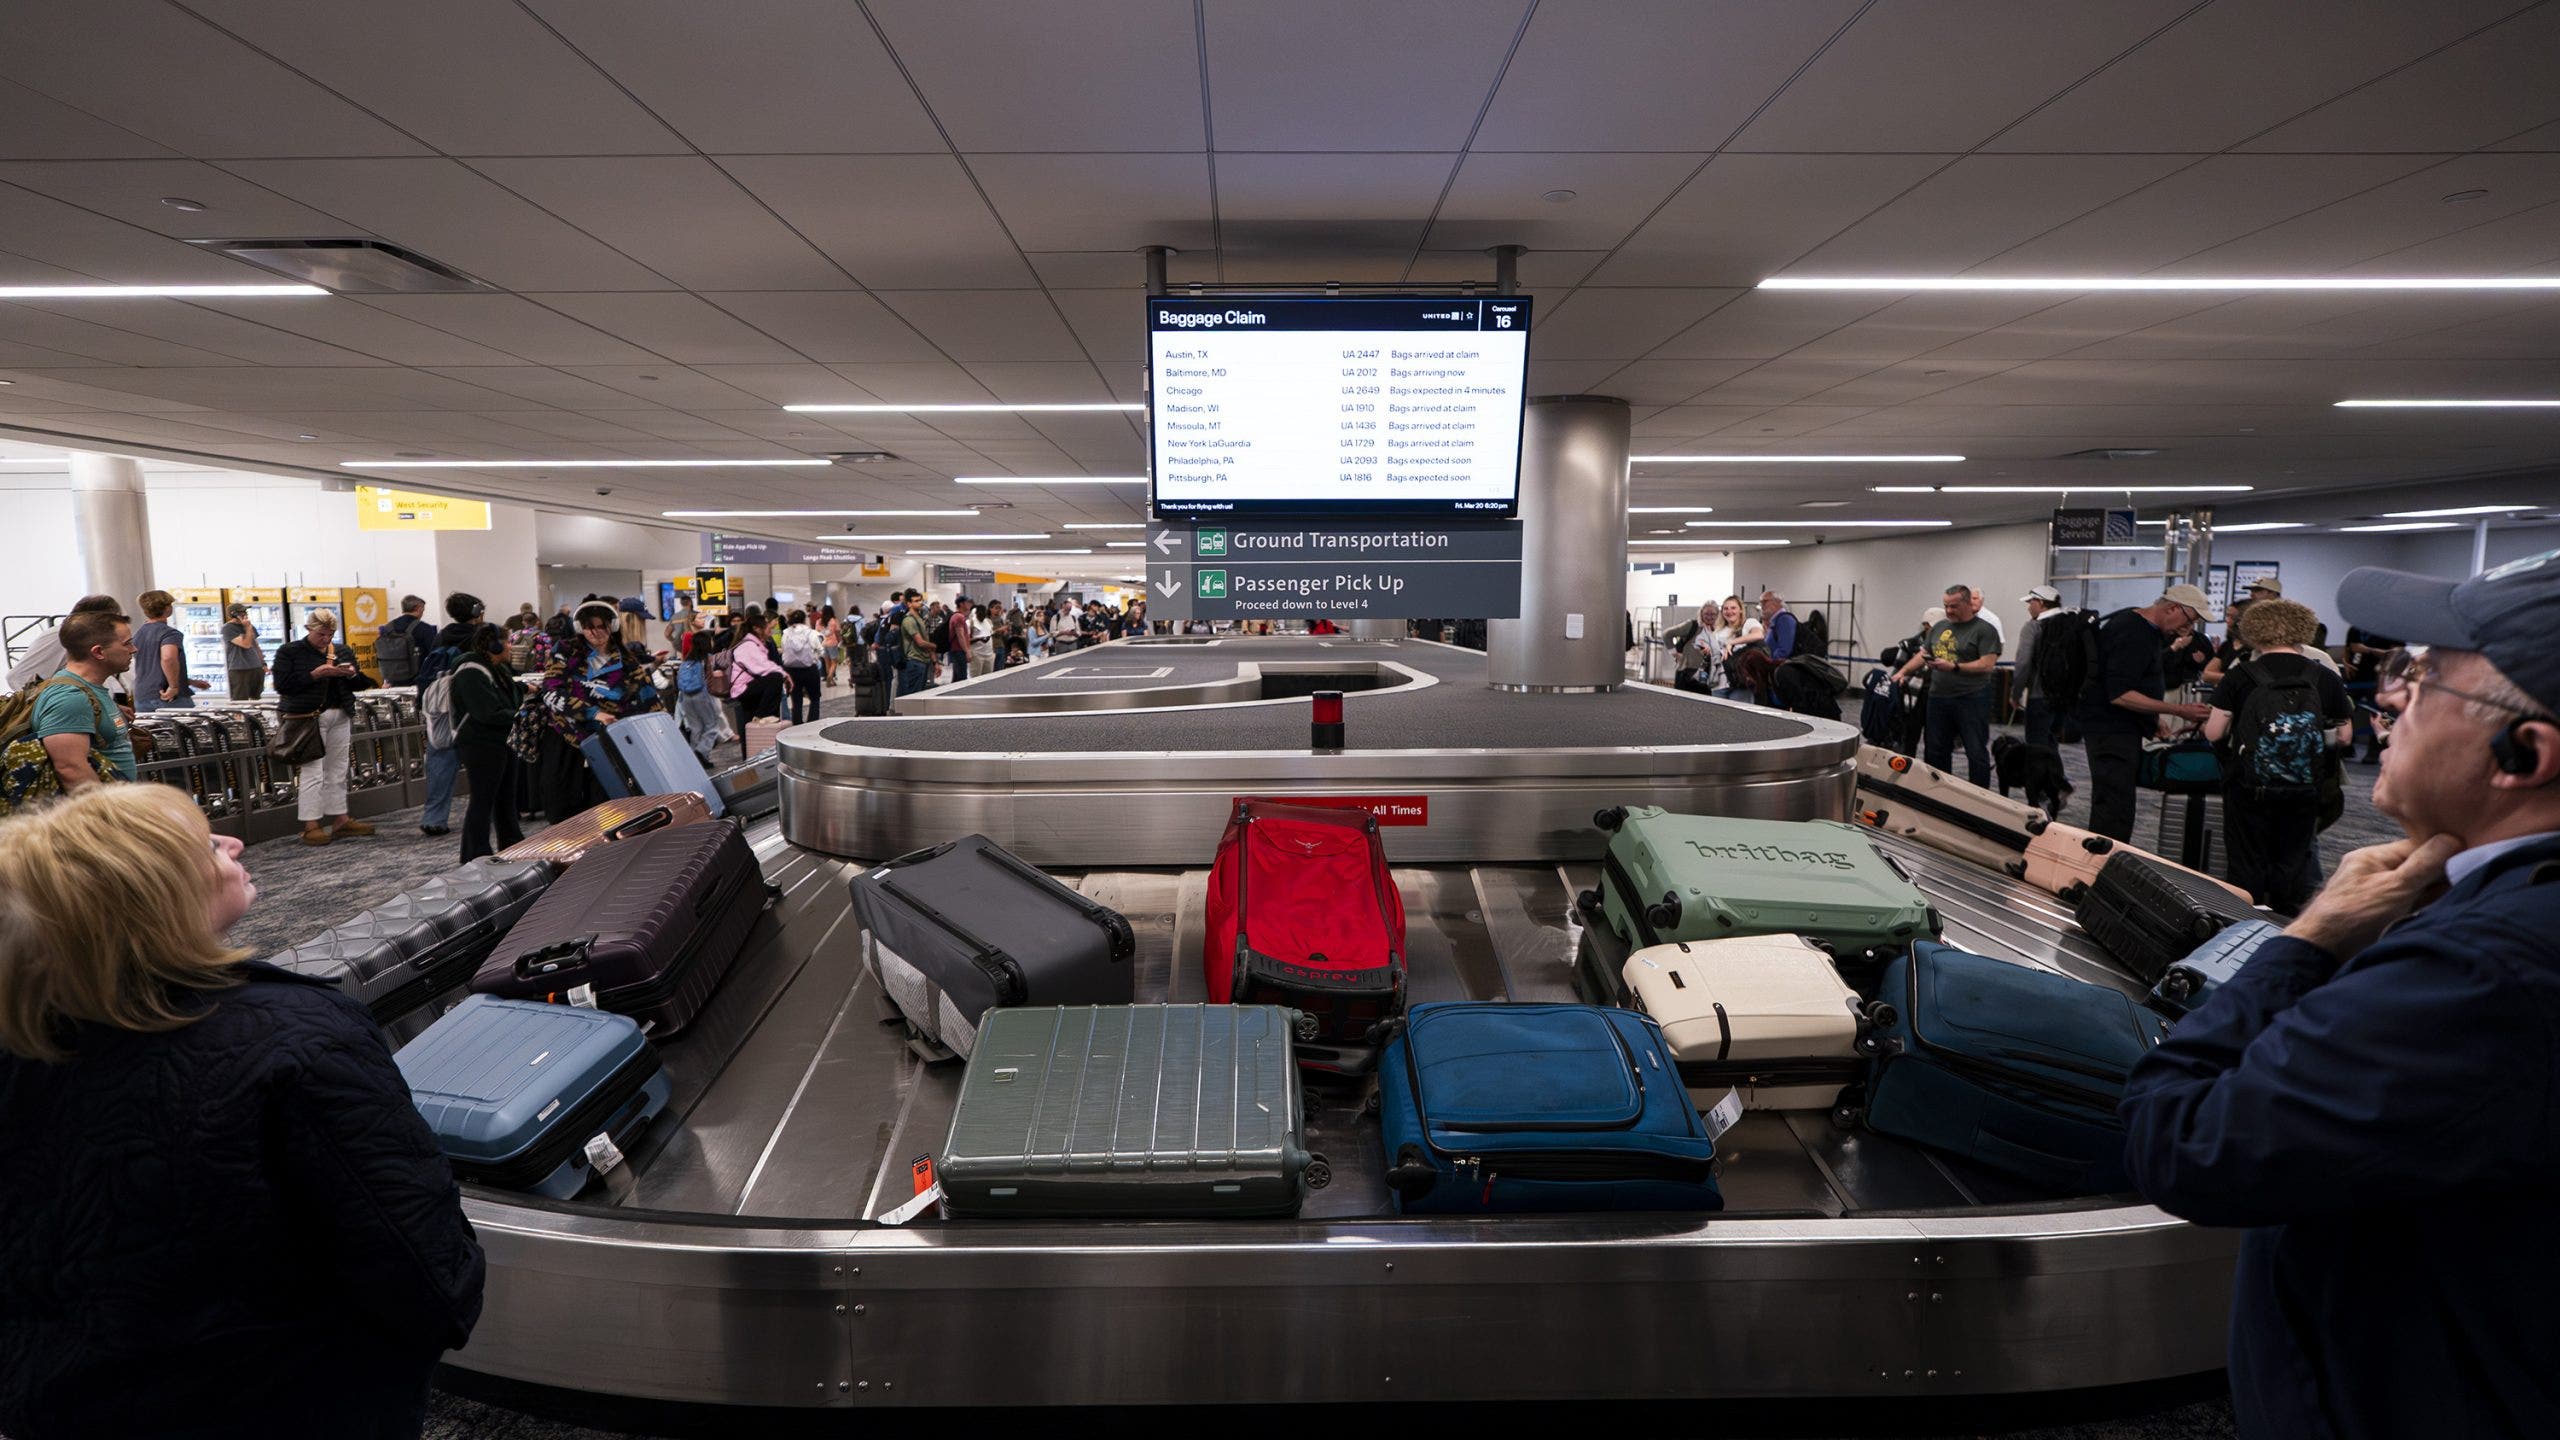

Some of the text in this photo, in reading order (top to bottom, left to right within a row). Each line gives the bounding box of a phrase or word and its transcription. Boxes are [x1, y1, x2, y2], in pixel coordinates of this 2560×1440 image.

[1159, 310, 1266, 328] Baggage Claim
[1495, 315, 1512, 328] 16
[1165, 350, 1209, 360] Austin, TX
[1342, 350, 1380, 359] UA 2447
[1391, 350, 1480, 361] Bags arrived at claim
[1165, 368, 1227, 378] Baltimore, MD
[1342, 368, 1378, 377] UA 2012
[1390, 368, 1412, 378] Bags
[1413, 368, 1446, 378] arriving
[1166, 386, 1203, 397] Chicago
[1341, 386, 1355, 395] UA
[1389, 386, 1412, 397] Bags
[1412, 386, 1454, 396] expected
[1463, 386, 1471, 394] 4
[1471, 387, 1506, 395] minutes
[1166, 404, 1220, 414] Madison, WI
[1341, 404, 1375, 412] UA 1910
[1389, 404, 1477, 414] Bags arrived at claim
[1167, 422, 1222, 431] Missoula, MT
[1340, 422, 1354, 430] UA
[1388, 421, 1410, 431] Bags
[1410, 422, 1442, 430] arrived
[1451, 422, 1476, 430] claim
[1167, 440, 1252, 448] New York LaGuardia
[1340, 439, 1375, 448] UA 1729
[1387, 439, 1409, 449] Bags
[1410, 439, 1441, 447] arrived
[1450, 439, 1475, 447] claim
[1168, 456, 1235, 467] Philadelphia, PA
[1340, 456, 1378, 465] UA 2093
[1387, 456, 1409, 466] Bags
[1409, 456, 1450, 466] expected
[1168, 473, 1228, 484] Pittsburgh, PA
[1339, 473, 1373, 482] UA 1816
[1386, 473, 1408, 483] Bags
[1408, 473, 1449, 483] expected
[396, 501, 448, 510] West Security
[1177, 503, 1187, 511] you
[2056, 515, 2101, 528] Baggage
[2060, 529, 2097, 539] Service
[1233, 531, 1449, 552] Ground Transportation
[1234, 574, 1405, 596] Passenger Pick Up
[1235, 599, 1369, 610] Proceed down to Level 4
[1372, 804, 1387, 815] All
[1390, 804, 1422, 815] Times
[1684, 840, 1856, 870] britbag
[1282, 966, 1358, 982] osprey
